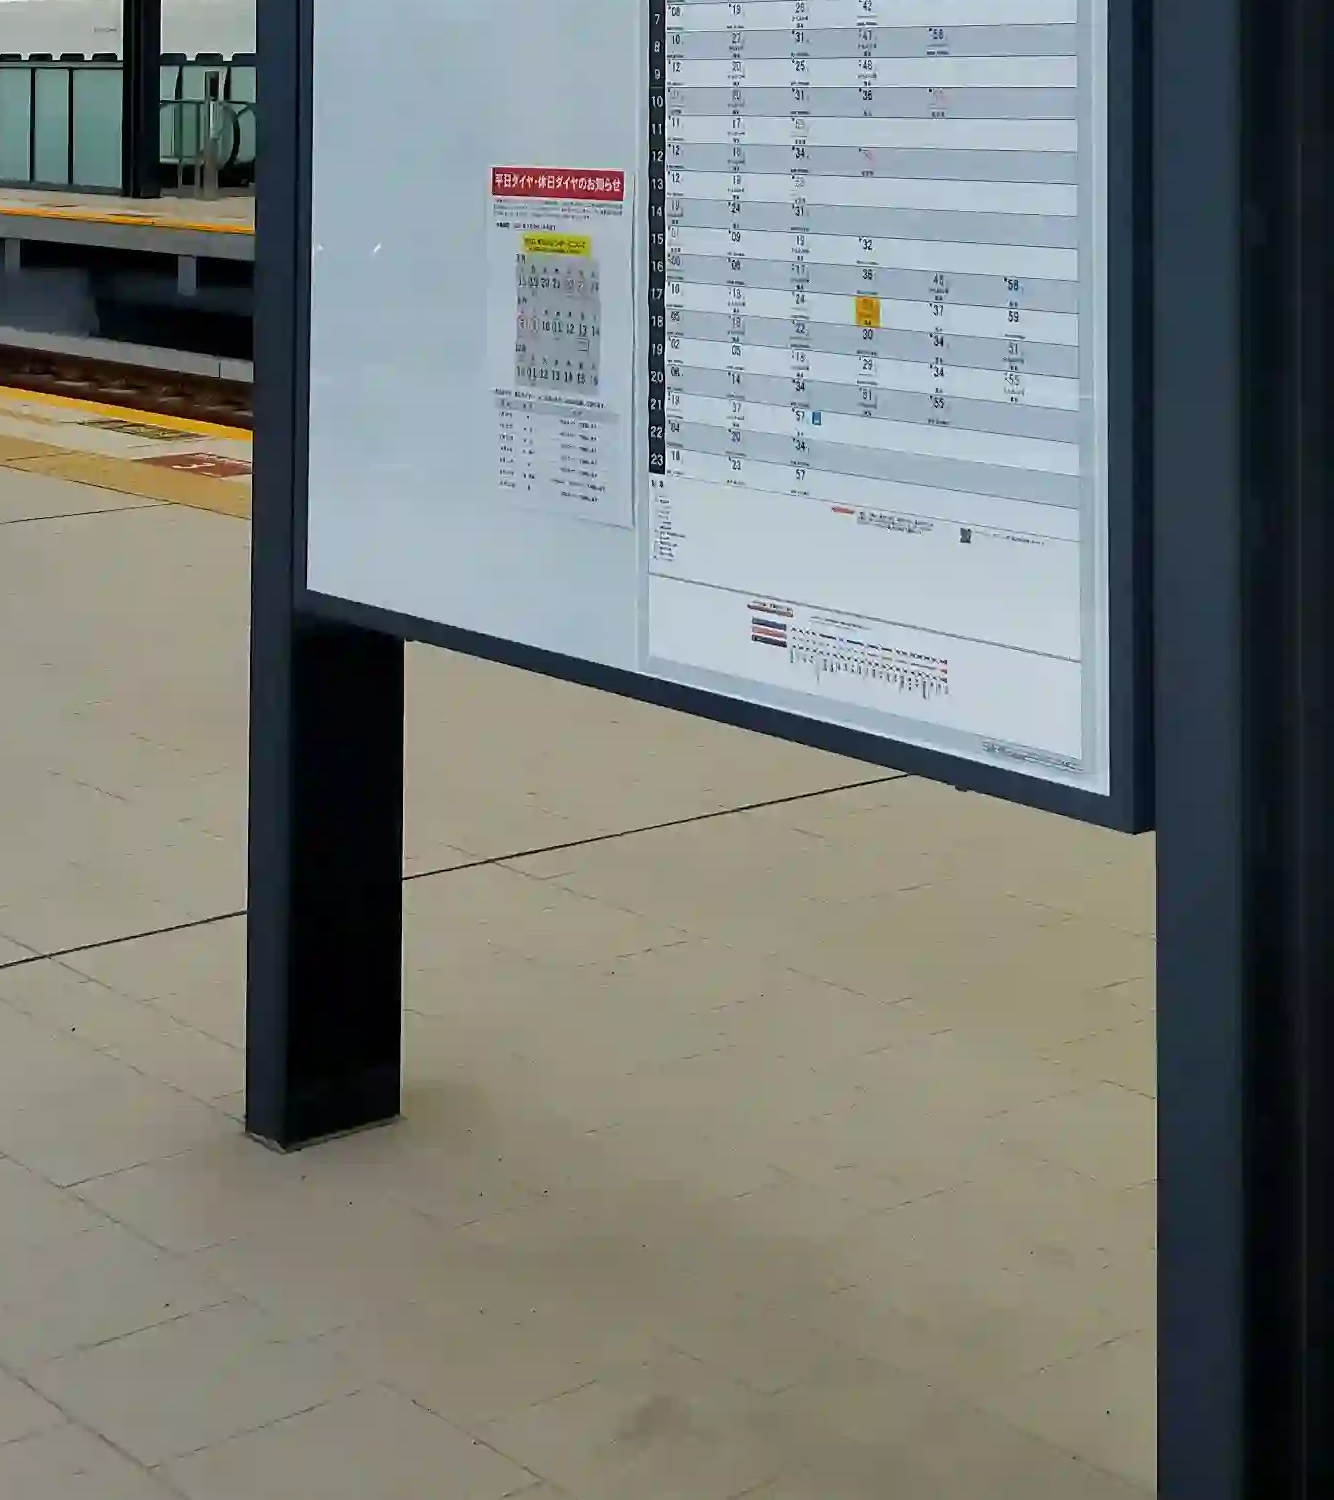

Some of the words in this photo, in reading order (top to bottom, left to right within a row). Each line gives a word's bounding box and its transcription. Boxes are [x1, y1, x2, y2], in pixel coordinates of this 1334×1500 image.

[654, 13, 661, 25] 7
[654, 41, 661, 52] 8
[654, 68, 661, 80] 9
[651, 96, 664, 107] 10
[651, 123, 664, 135] 11
[651, 150, 664, 162] 12
[651, 178, 664, 189] 13
[651, 205, 664, 217] 14
[651, 234, 664, 245] 15
[651, 261, 664, 272] 16
[651, 288, 664, 300] 17
[651, 315, 664, 327] 18
[651, 343, 664, 355] 19
[651, 371, 664, 383] 20
[651, 398, 664, 410] 21
[651, 425, 664, 437] 22
[651, 453, 664, 465] 23
